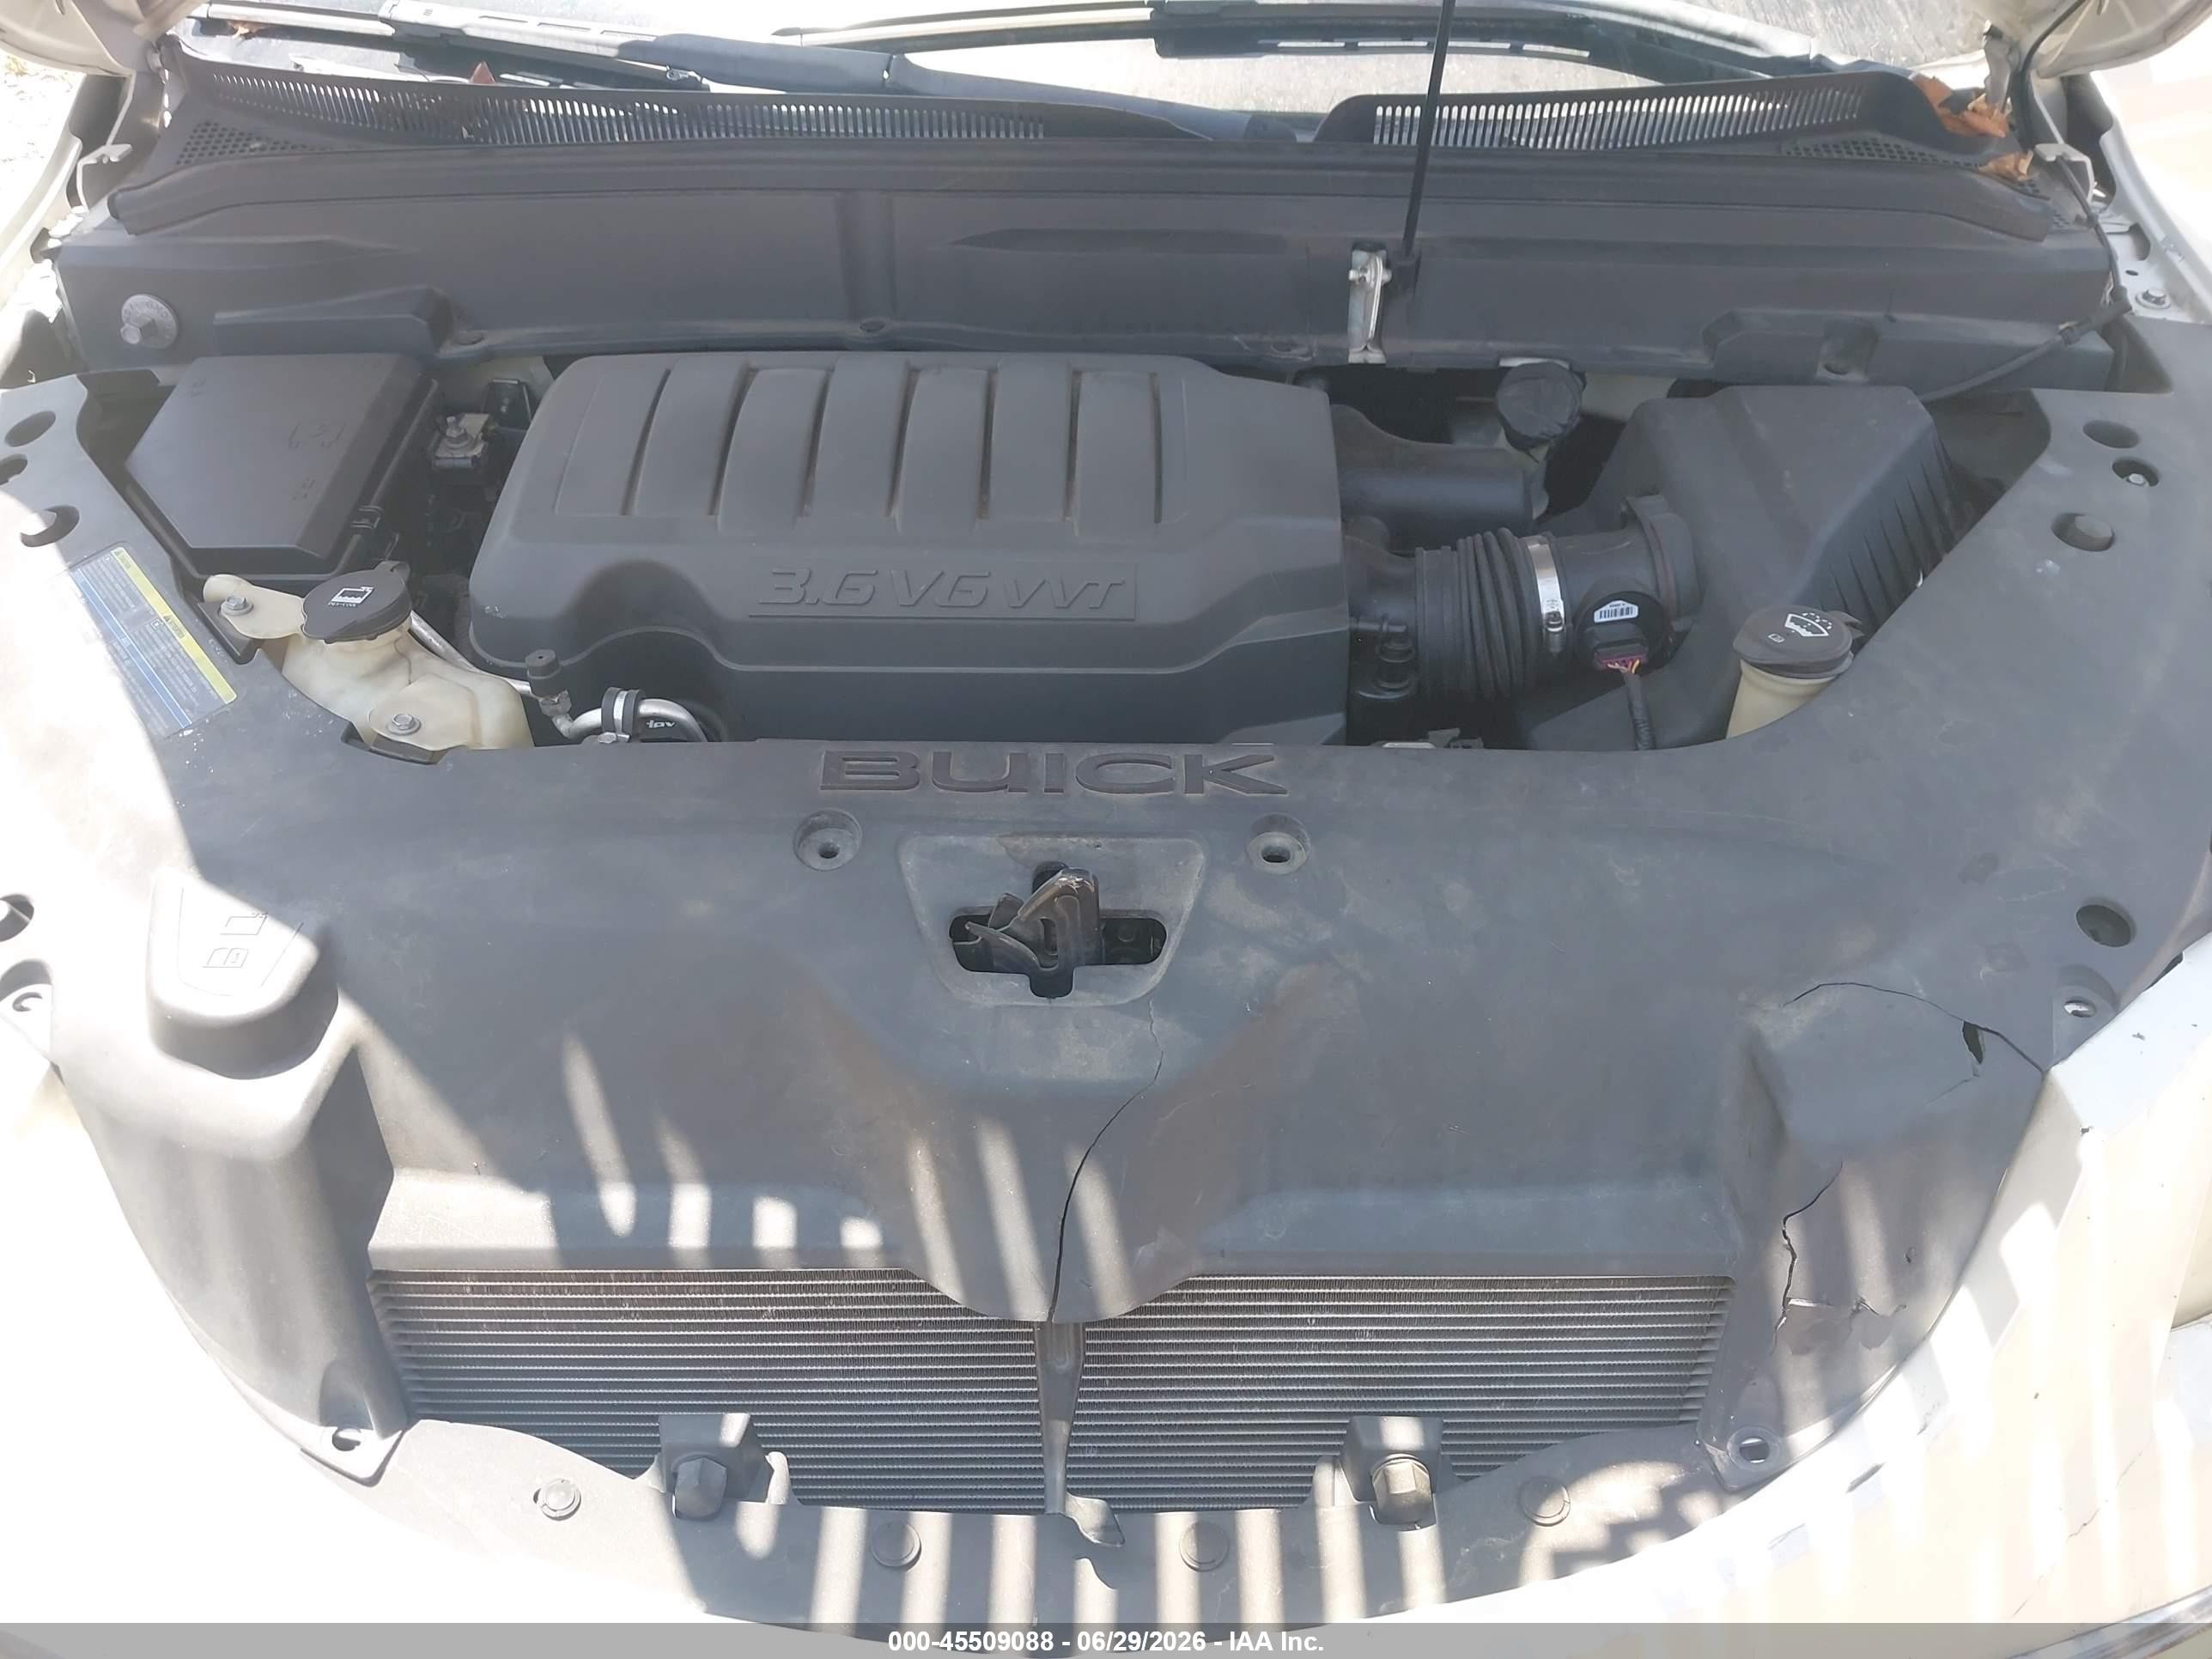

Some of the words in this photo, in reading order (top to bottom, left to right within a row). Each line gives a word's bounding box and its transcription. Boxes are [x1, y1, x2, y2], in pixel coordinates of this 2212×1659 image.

[758, 567, 879, 608] 3.6
[890, 569, 992, 609] V6
[1004, 576, 1126, 611] VVT
[819, 749, 1289, 796] BUICK
